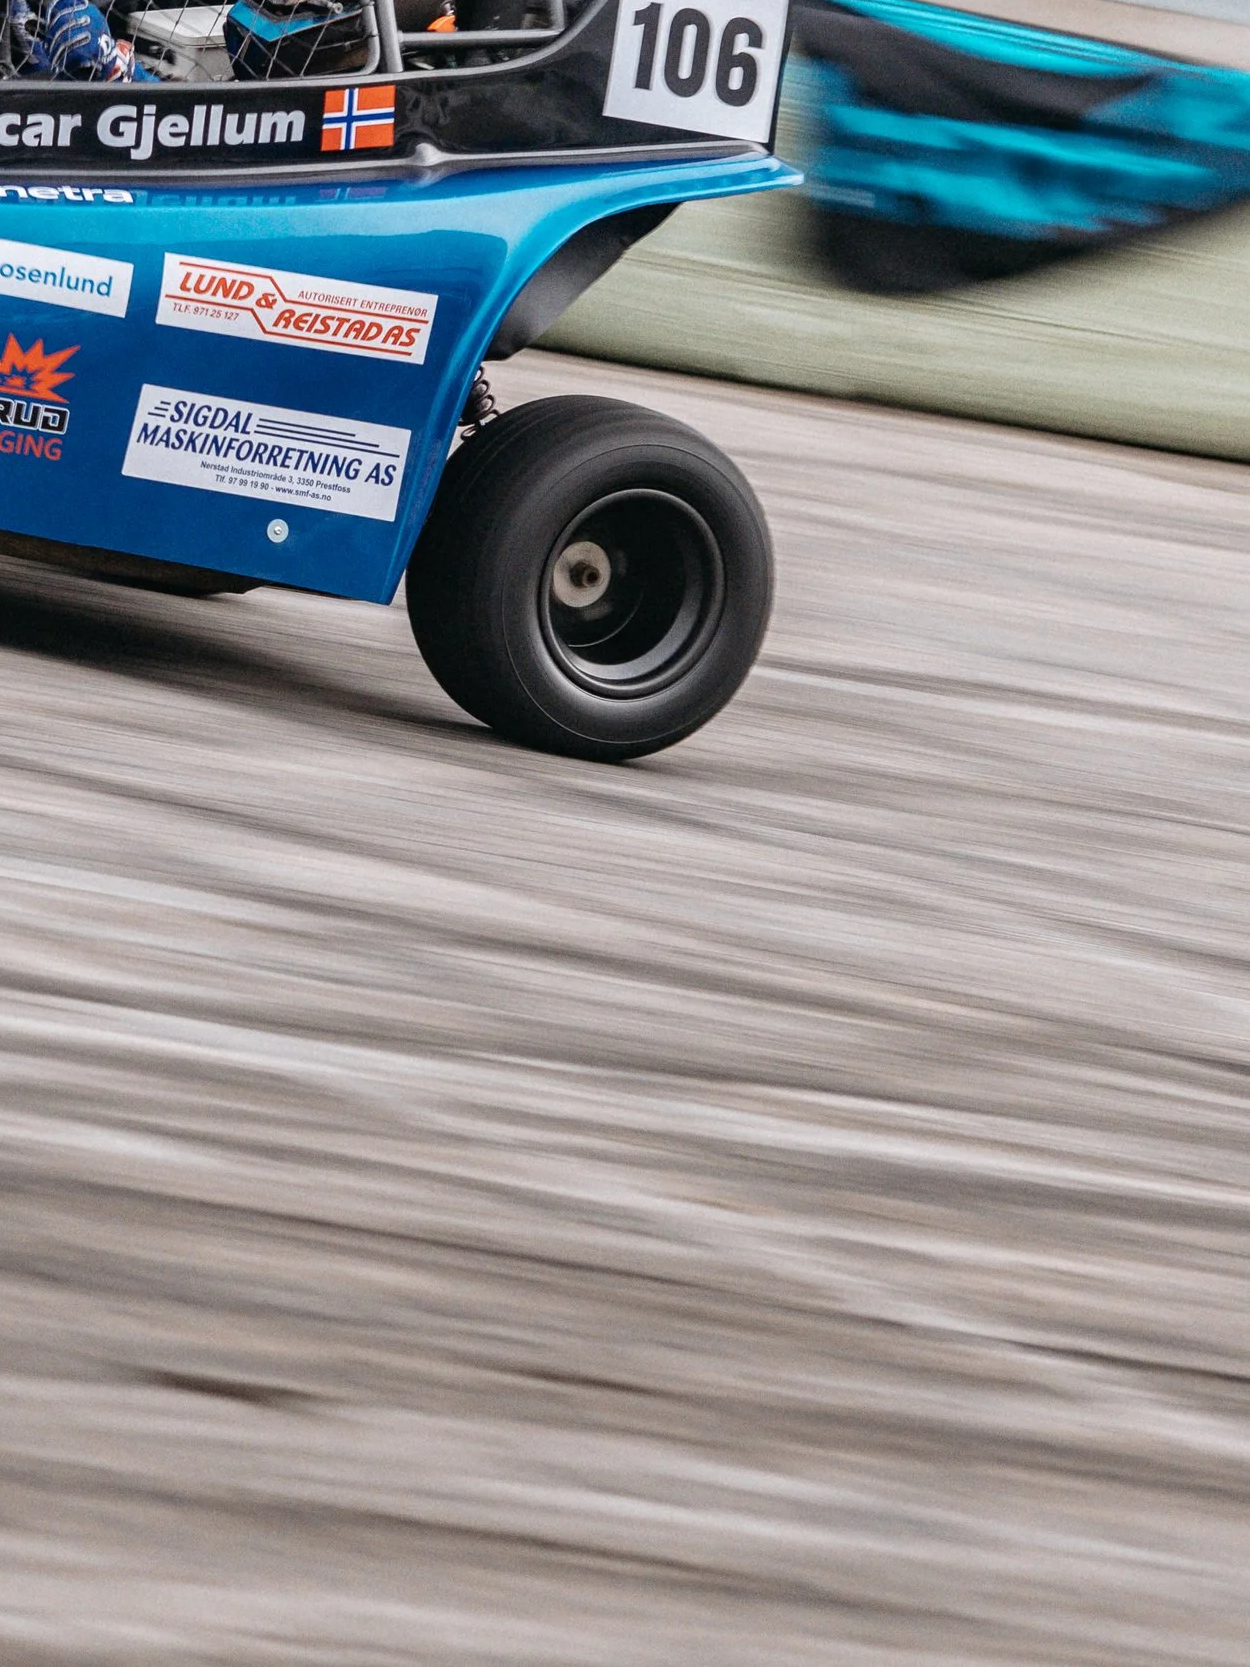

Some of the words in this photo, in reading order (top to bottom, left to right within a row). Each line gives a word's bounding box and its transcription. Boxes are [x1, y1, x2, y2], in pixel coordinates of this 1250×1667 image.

[632, 1, 766, 108] 106
[97, 104, 306, 160] Gjellum
[180, 271, 255, 301] LUND
[255, 292, 278, 310] &
[297, 289, 360, 308] AUTORISERT
[360, 299, 428, 318] ENTREPRENØR
[194, 305, 210, 317] 971
[210, 309, 222, 319] 25
[224, 311, 240, 321] 127
[272, 309, 384, 341] REISTAD
[380, 325, 421, 348] AS
[169, 400, 253, 435] SIGDAL
[136, 422, 363, 481] MASKINFORRETNING
[364, 462, 397, 486] AS
[200, 460, 229, 473] Nerstad
[230, 465, 287, 483] Industriområde
[296, 476, 314, 488] 3350
[315, 480, 351, 494] Prestfoss
[228, 476, 237, 485] 97
[238, 478, 248, 487] 99
[250, 479, 259, 489] 19
[275, 485, 332, 502] www.smf-as.no
